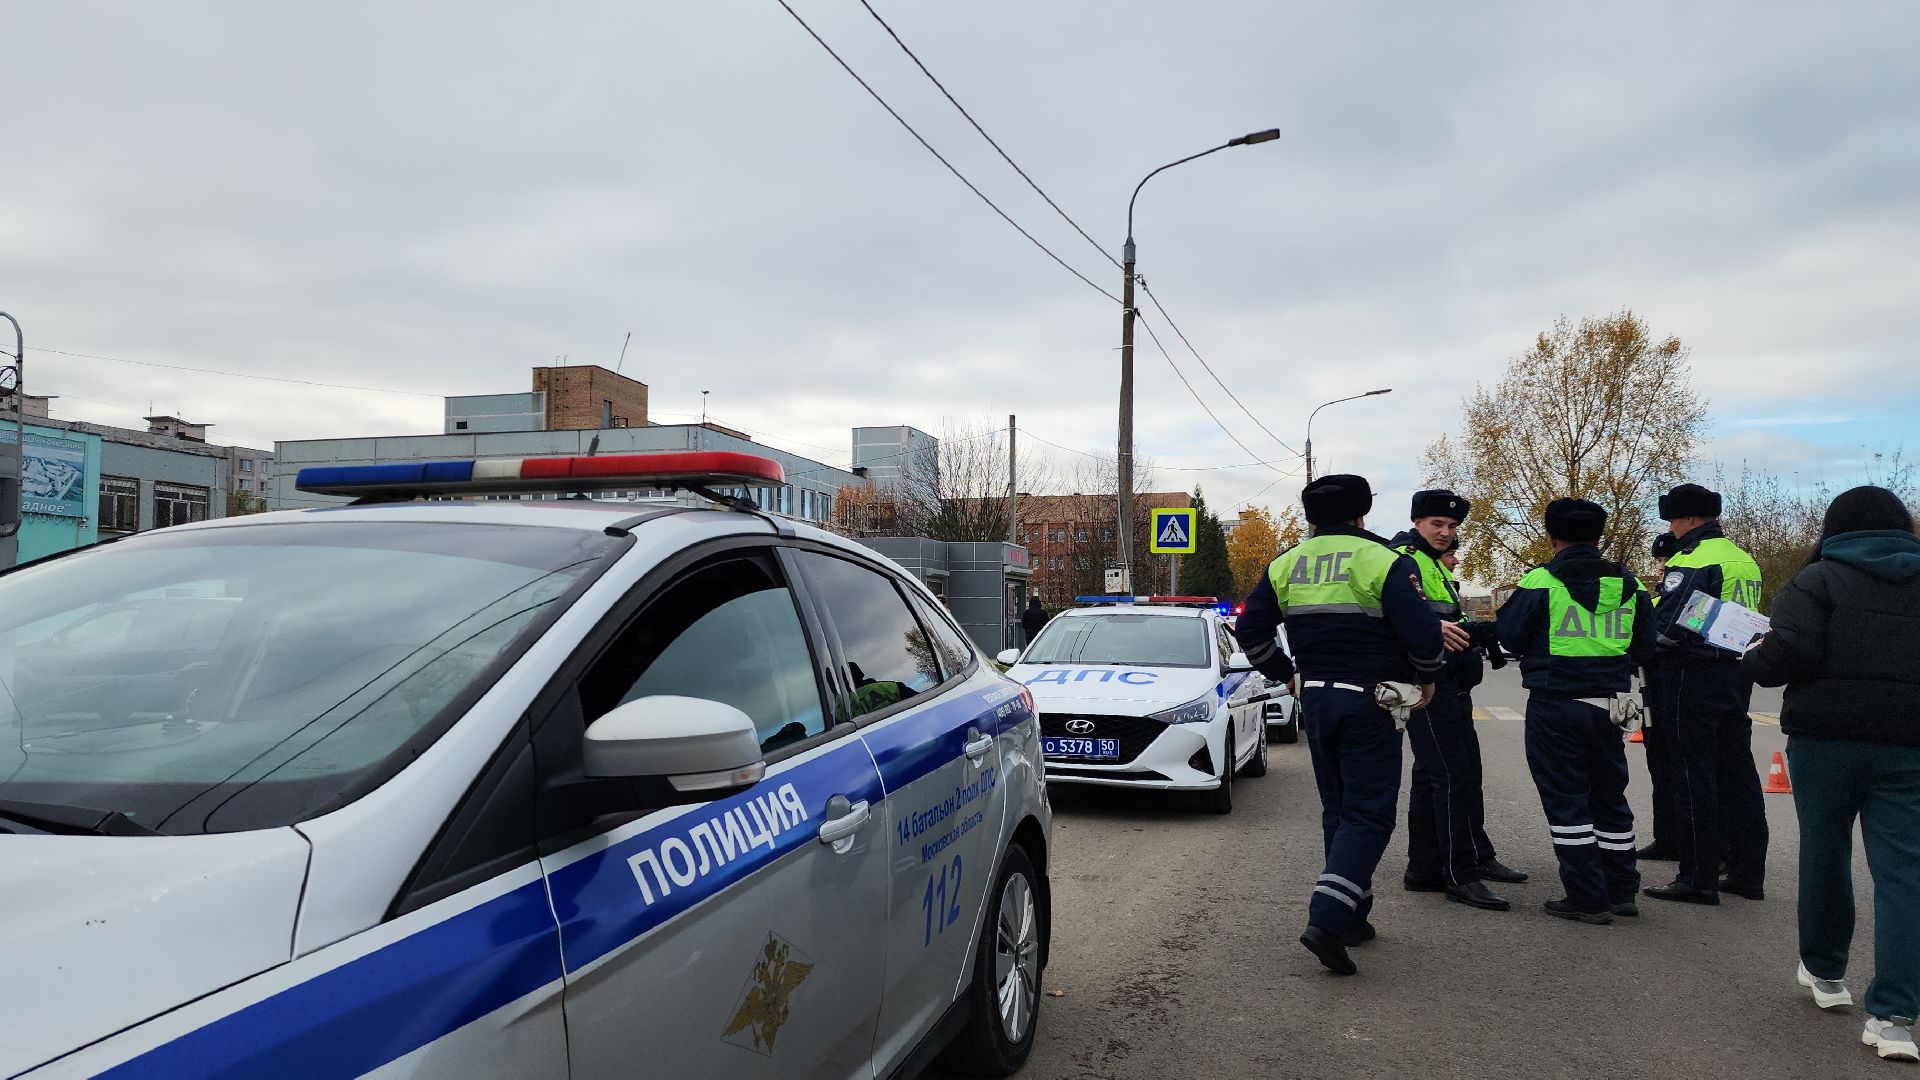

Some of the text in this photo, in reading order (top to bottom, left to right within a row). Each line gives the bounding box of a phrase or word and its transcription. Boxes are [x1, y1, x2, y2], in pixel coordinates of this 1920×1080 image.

[1288, 552, 1353, 584] ДПС
[1024, 669, 1158, 685] ДПС
[1060, 740, 1093, 753] 5378
[1101, 740, 1115, 751] 50
[897, 766, 996, 846] 14 батальон 2 полк ДПС
[627, 782, 809, 906] ПОЛИЦИЯ
[921, 811, 984, 864] Московская область
[923, 854, 962, 948] 112
